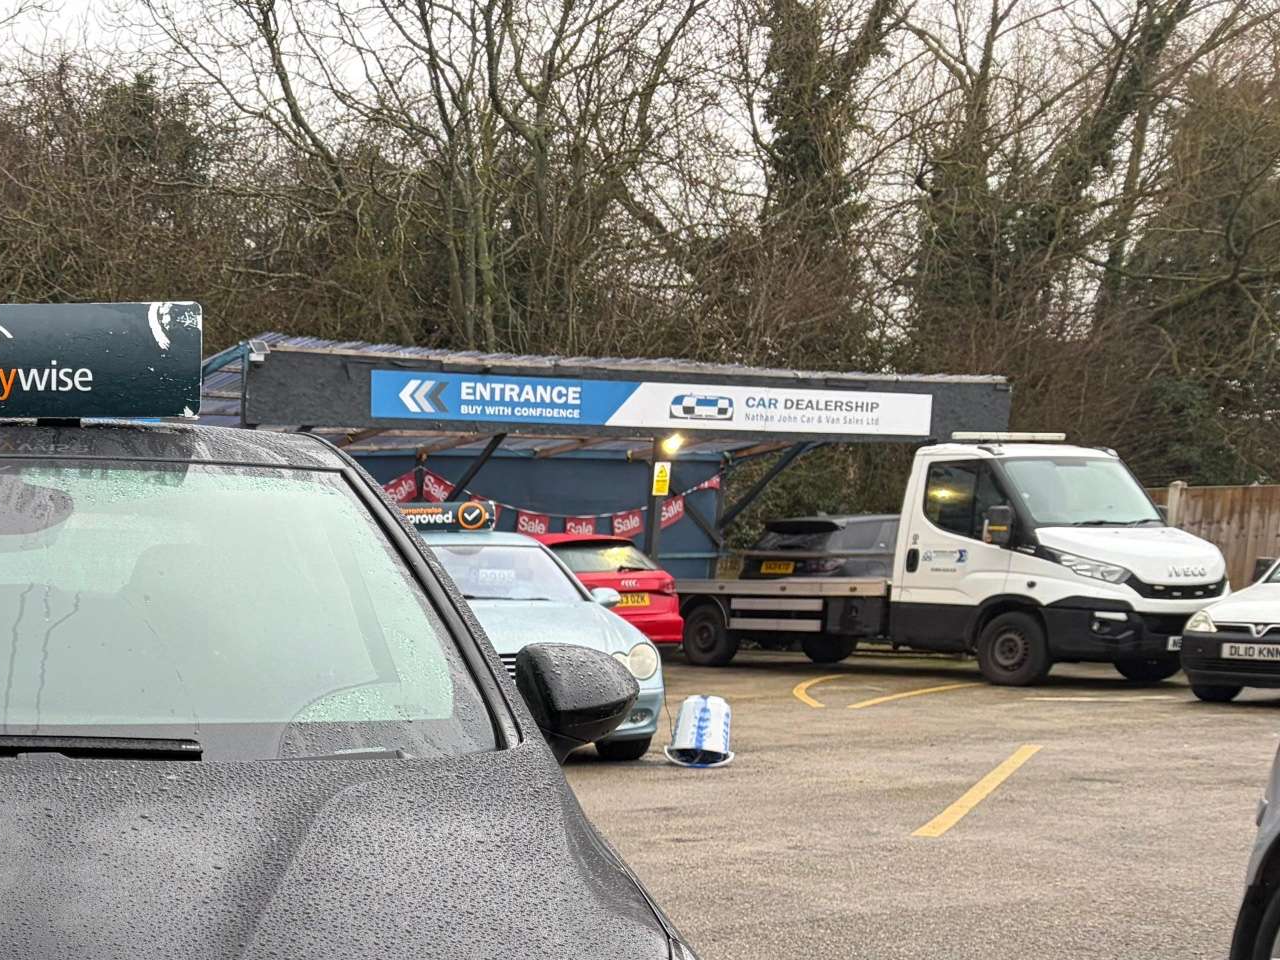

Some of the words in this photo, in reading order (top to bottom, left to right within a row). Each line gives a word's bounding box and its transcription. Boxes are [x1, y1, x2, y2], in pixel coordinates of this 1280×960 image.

[460, 382, 582, 405] ENTRANCE
[460, 404, 482, 415] BUY
[484, 406, 512, 416] WITH
[514, 407, 580, 418] CONFIDENCE
[745, 396, 779, 409] CAR
[783, 398, 880, 413] DEALERSHIP
[745, 413, 774, 422] Nathan
[777, 415, 798, 424] John
[800, 415, 815, 424] Car
[818, 416, 823, 424] &
[825, 415, 840, 425] Van
[842, 416, 863, 426] Sales
[866, 416, 880, 426] Ltd
[386, 480, 415, 501] Sale
[423, 475, 449, 501] Sale
[660, 499, 684, 521] Sale
[519, 517, 545, 535] Sale
[566, 521, 594, 535] Sale
[614, 515, 641, 533] Sale
[1167, 566, 1207, 578] IVECO
[1229, 645, 1255, 657] DL10
